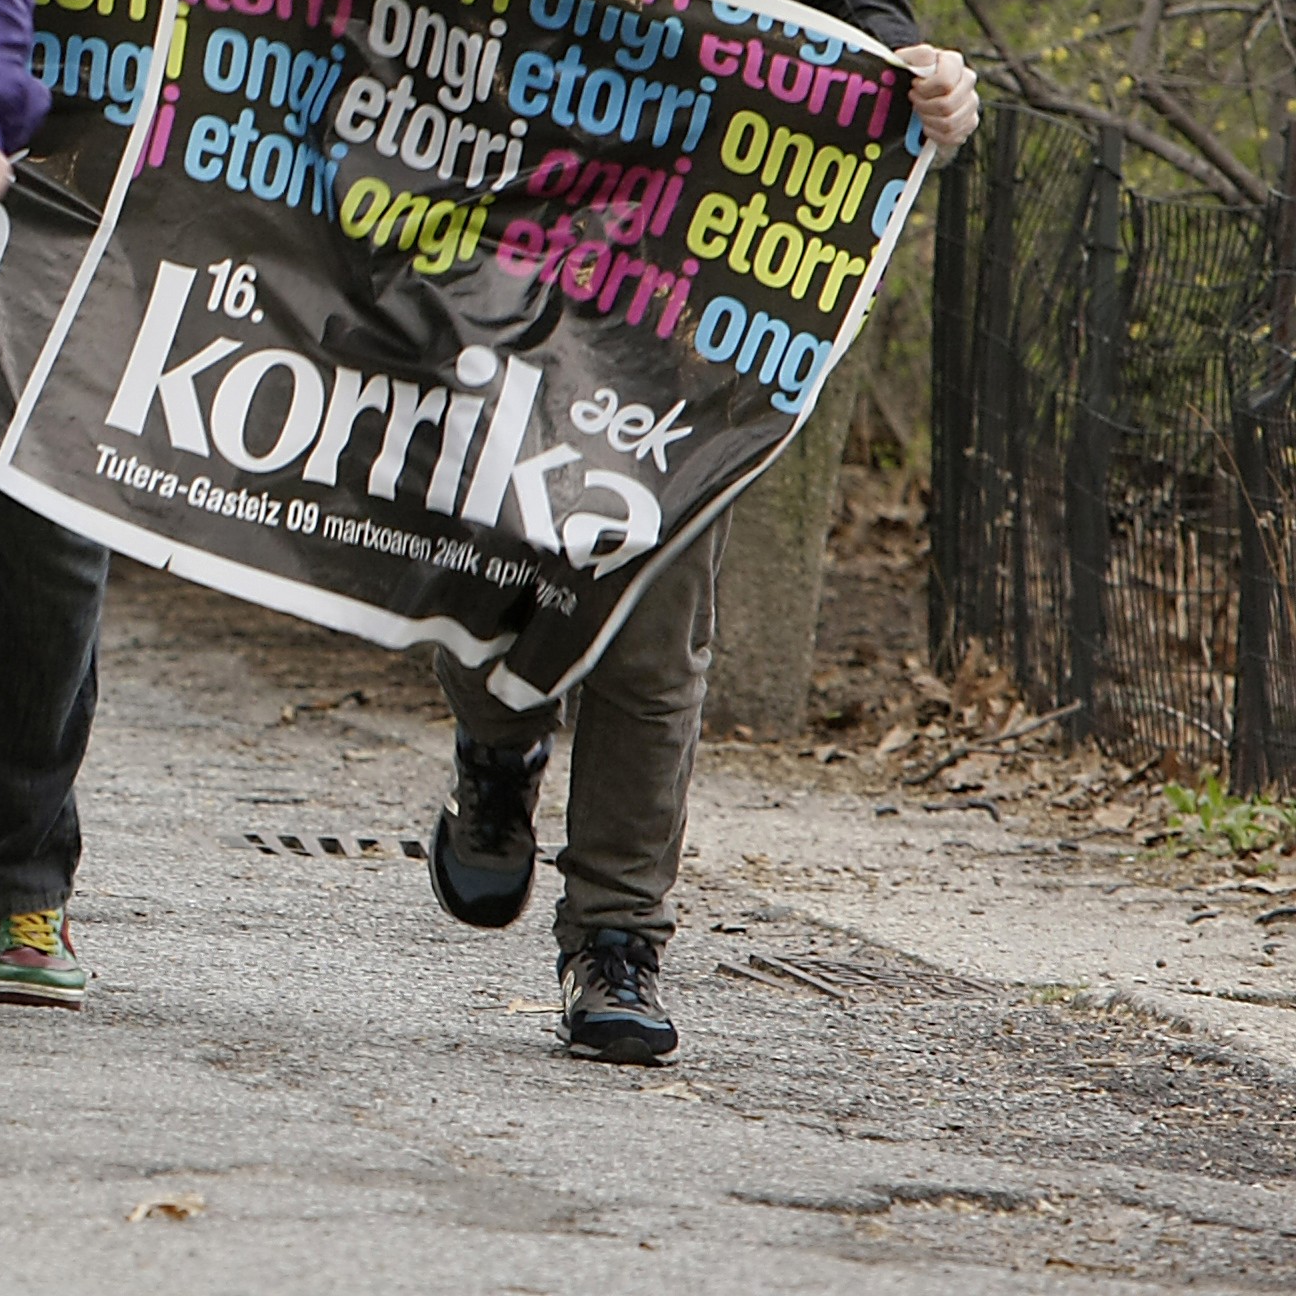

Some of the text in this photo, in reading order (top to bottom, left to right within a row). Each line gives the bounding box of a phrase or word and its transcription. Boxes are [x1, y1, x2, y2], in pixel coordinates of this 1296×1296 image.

[204, 26, 345, 138] ongi
[509, 45, 717, 152] etorri
[720, 109, 881, 233] ongi
[699, 32, 896, 138] etorri
[184, 107, 348, 222] etorri
[335, 74, 529, 192] etorri
[527, 149, 692, 246] ongi
[687, 191, 878, 313] etorr
[338, 176, 496, 275] ongi
[496, 213, 700, 339] etorri
[206, 257, 264, 324] 16.
[105, 260, 662, 580] korrika
[570, 388, 692, 474] aek
[95, 444, 280, 528] Tutera-Gasteiz
[287, 499, 320, 535] 09
[323, 511, 432, 562] martxoaren
